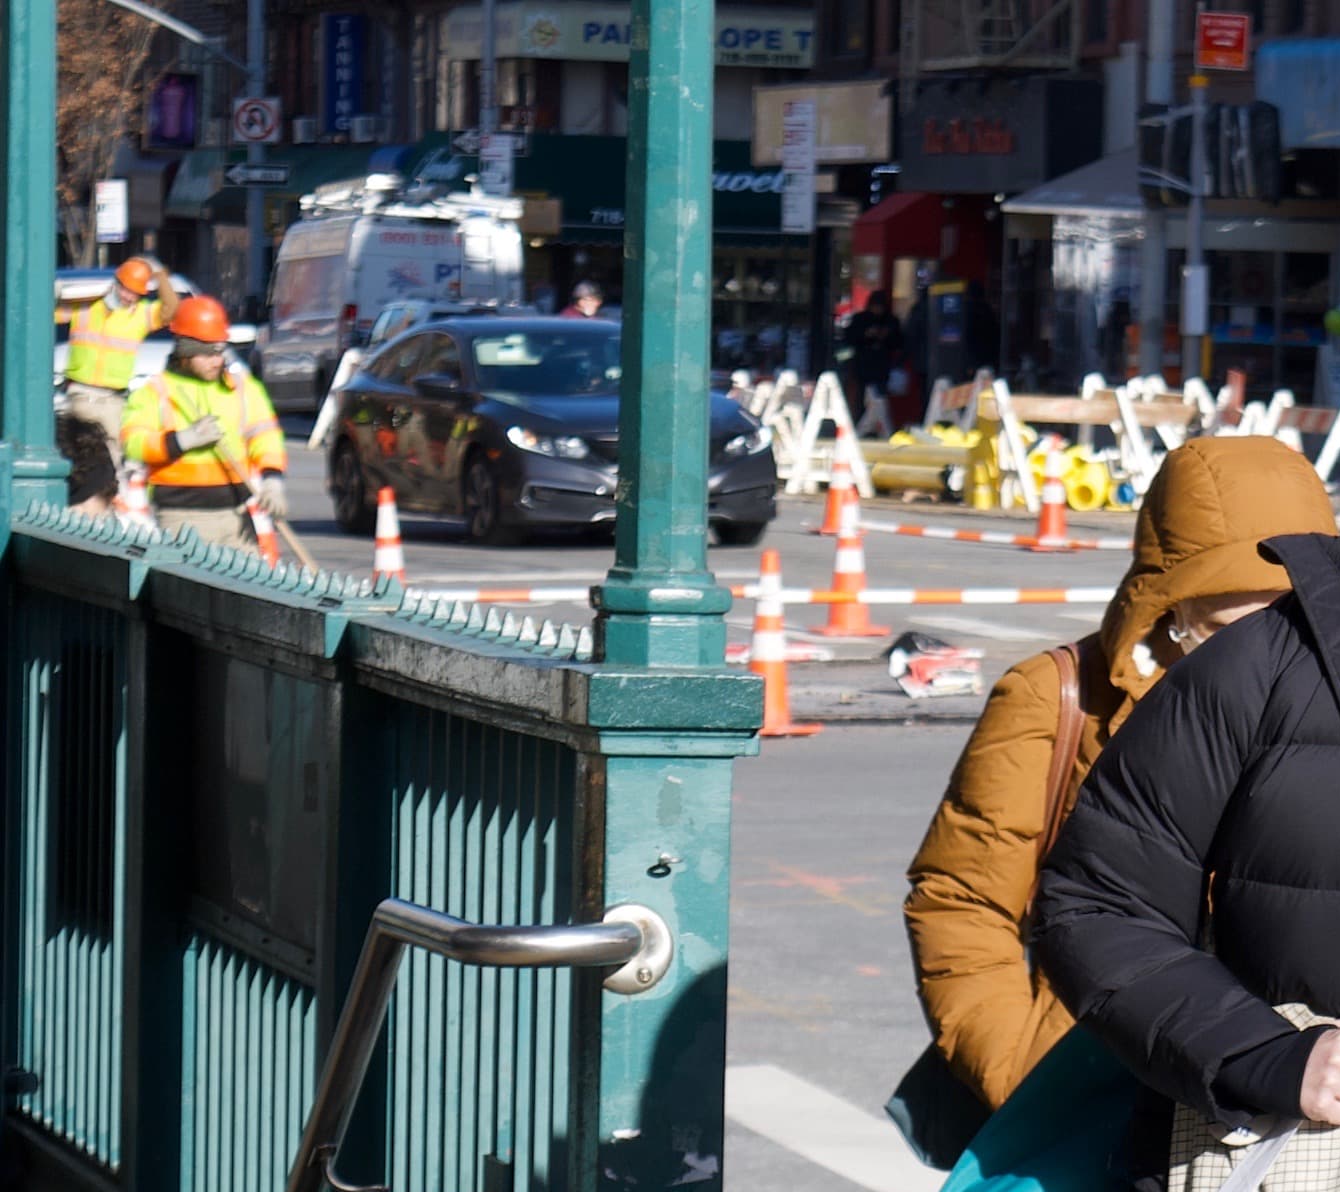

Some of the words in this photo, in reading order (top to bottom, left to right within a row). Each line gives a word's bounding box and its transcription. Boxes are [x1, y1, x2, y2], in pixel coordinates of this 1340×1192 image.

[718, 27, 783, 50] OPE
[335, 19, 352, 131] TANNING
[589, 208, 625, 225] 718-
